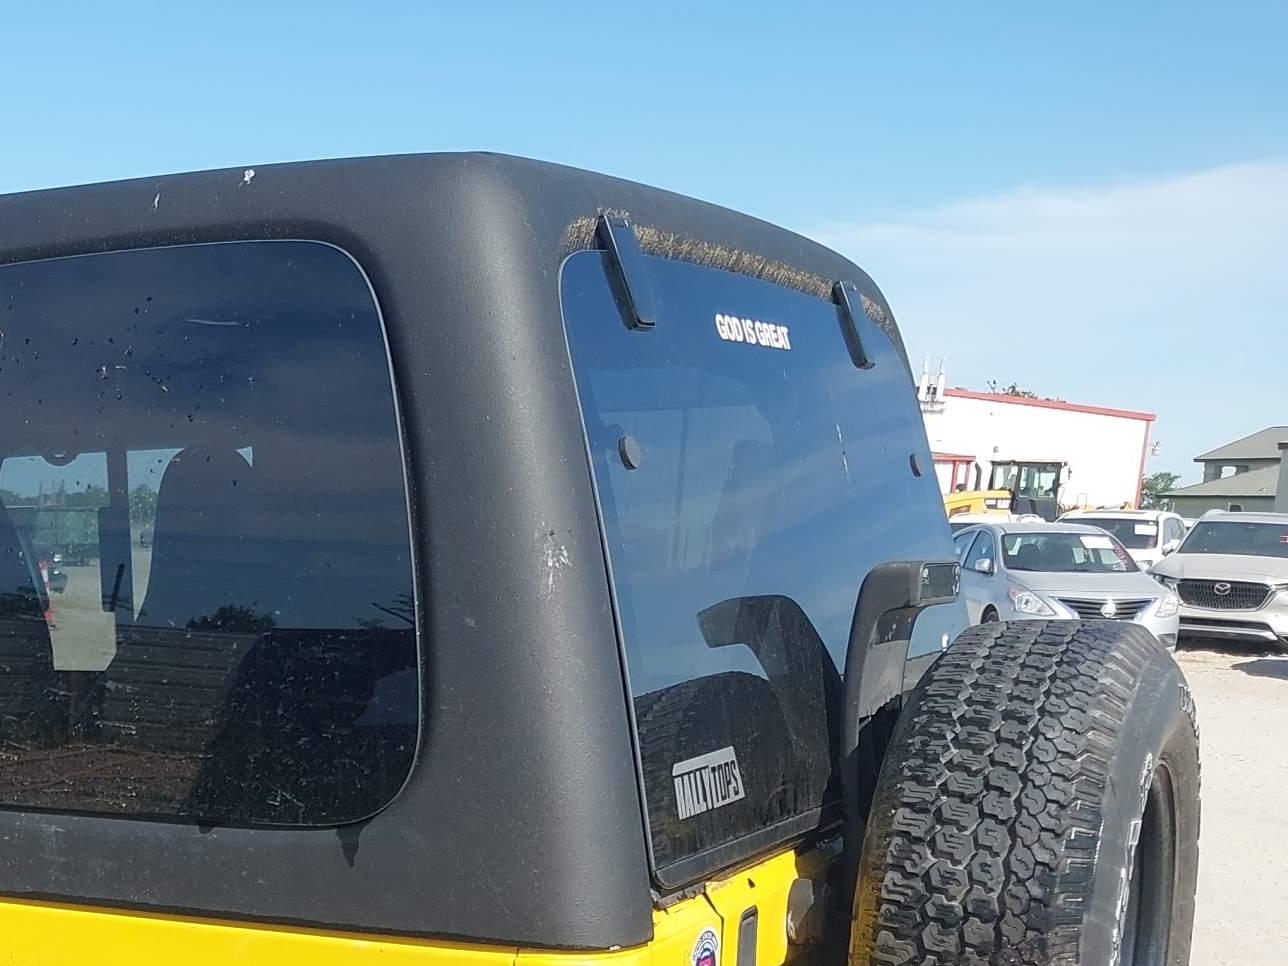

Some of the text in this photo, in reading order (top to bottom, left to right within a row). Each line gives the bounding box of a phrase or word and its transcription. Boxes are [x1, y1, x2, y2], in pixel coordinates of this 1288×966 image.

[715, 313, 791, 350] GOD IS GREAT
